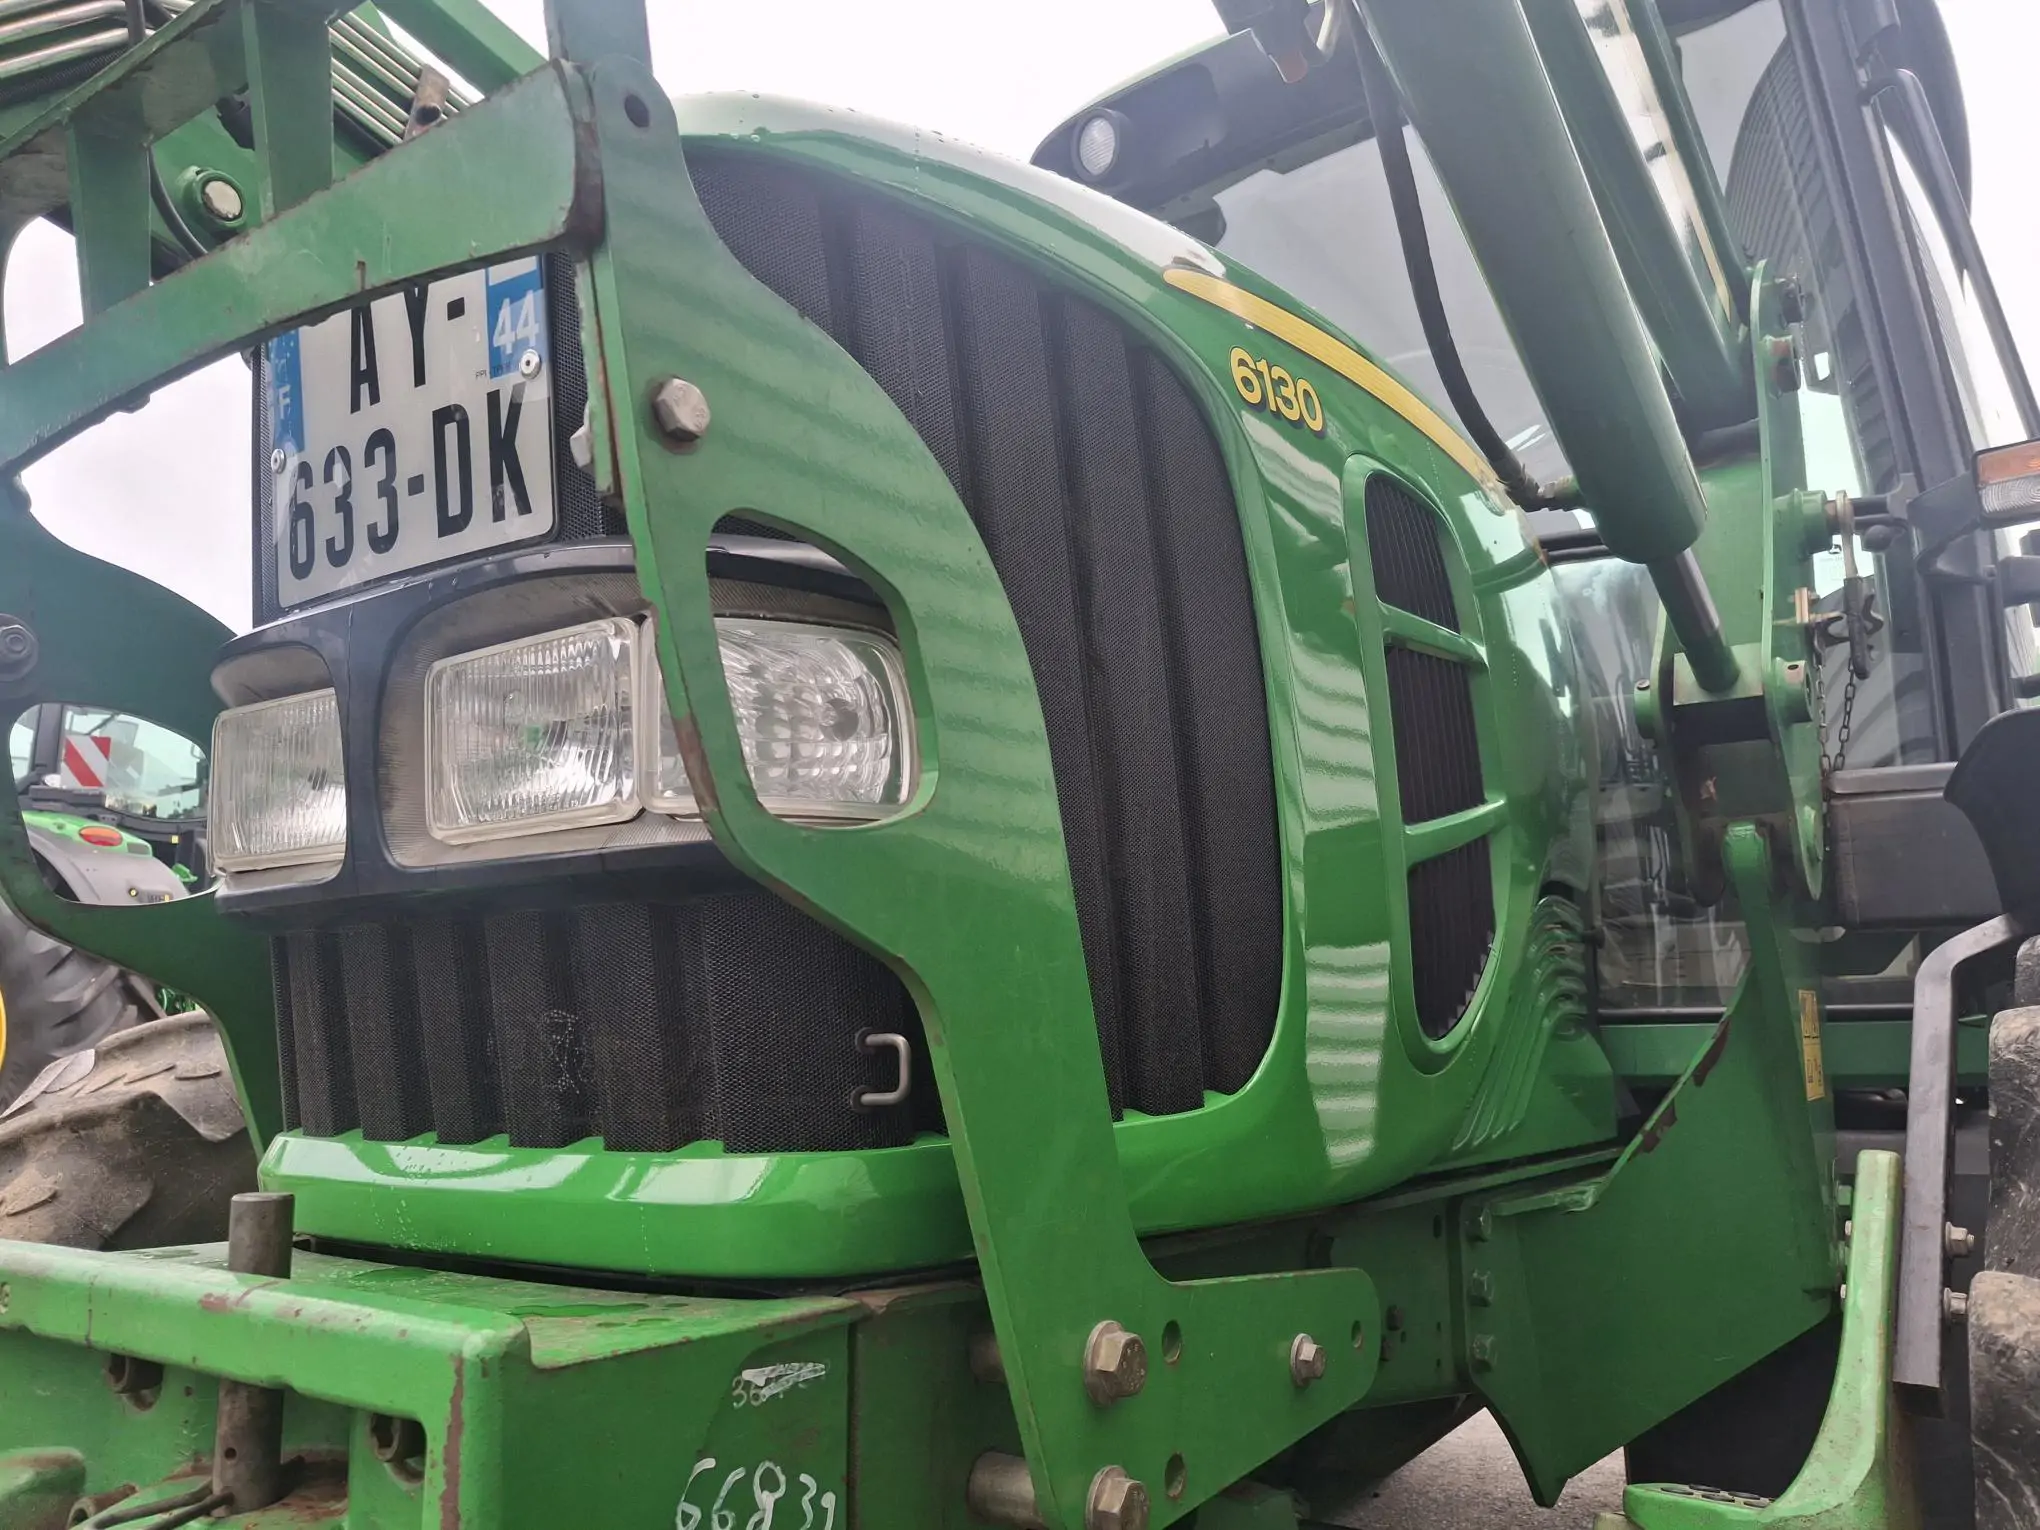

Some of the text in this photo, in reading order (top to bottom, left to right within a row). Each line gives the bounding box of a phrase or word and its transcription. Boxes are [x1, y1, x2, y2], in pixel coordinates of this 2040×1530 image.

[492, 289, 540, 356] 44
[277, 385, 291, 420] F
[1229, 345, 1324, 432] 6130
[289, 381, 532, 581] 633-DK
